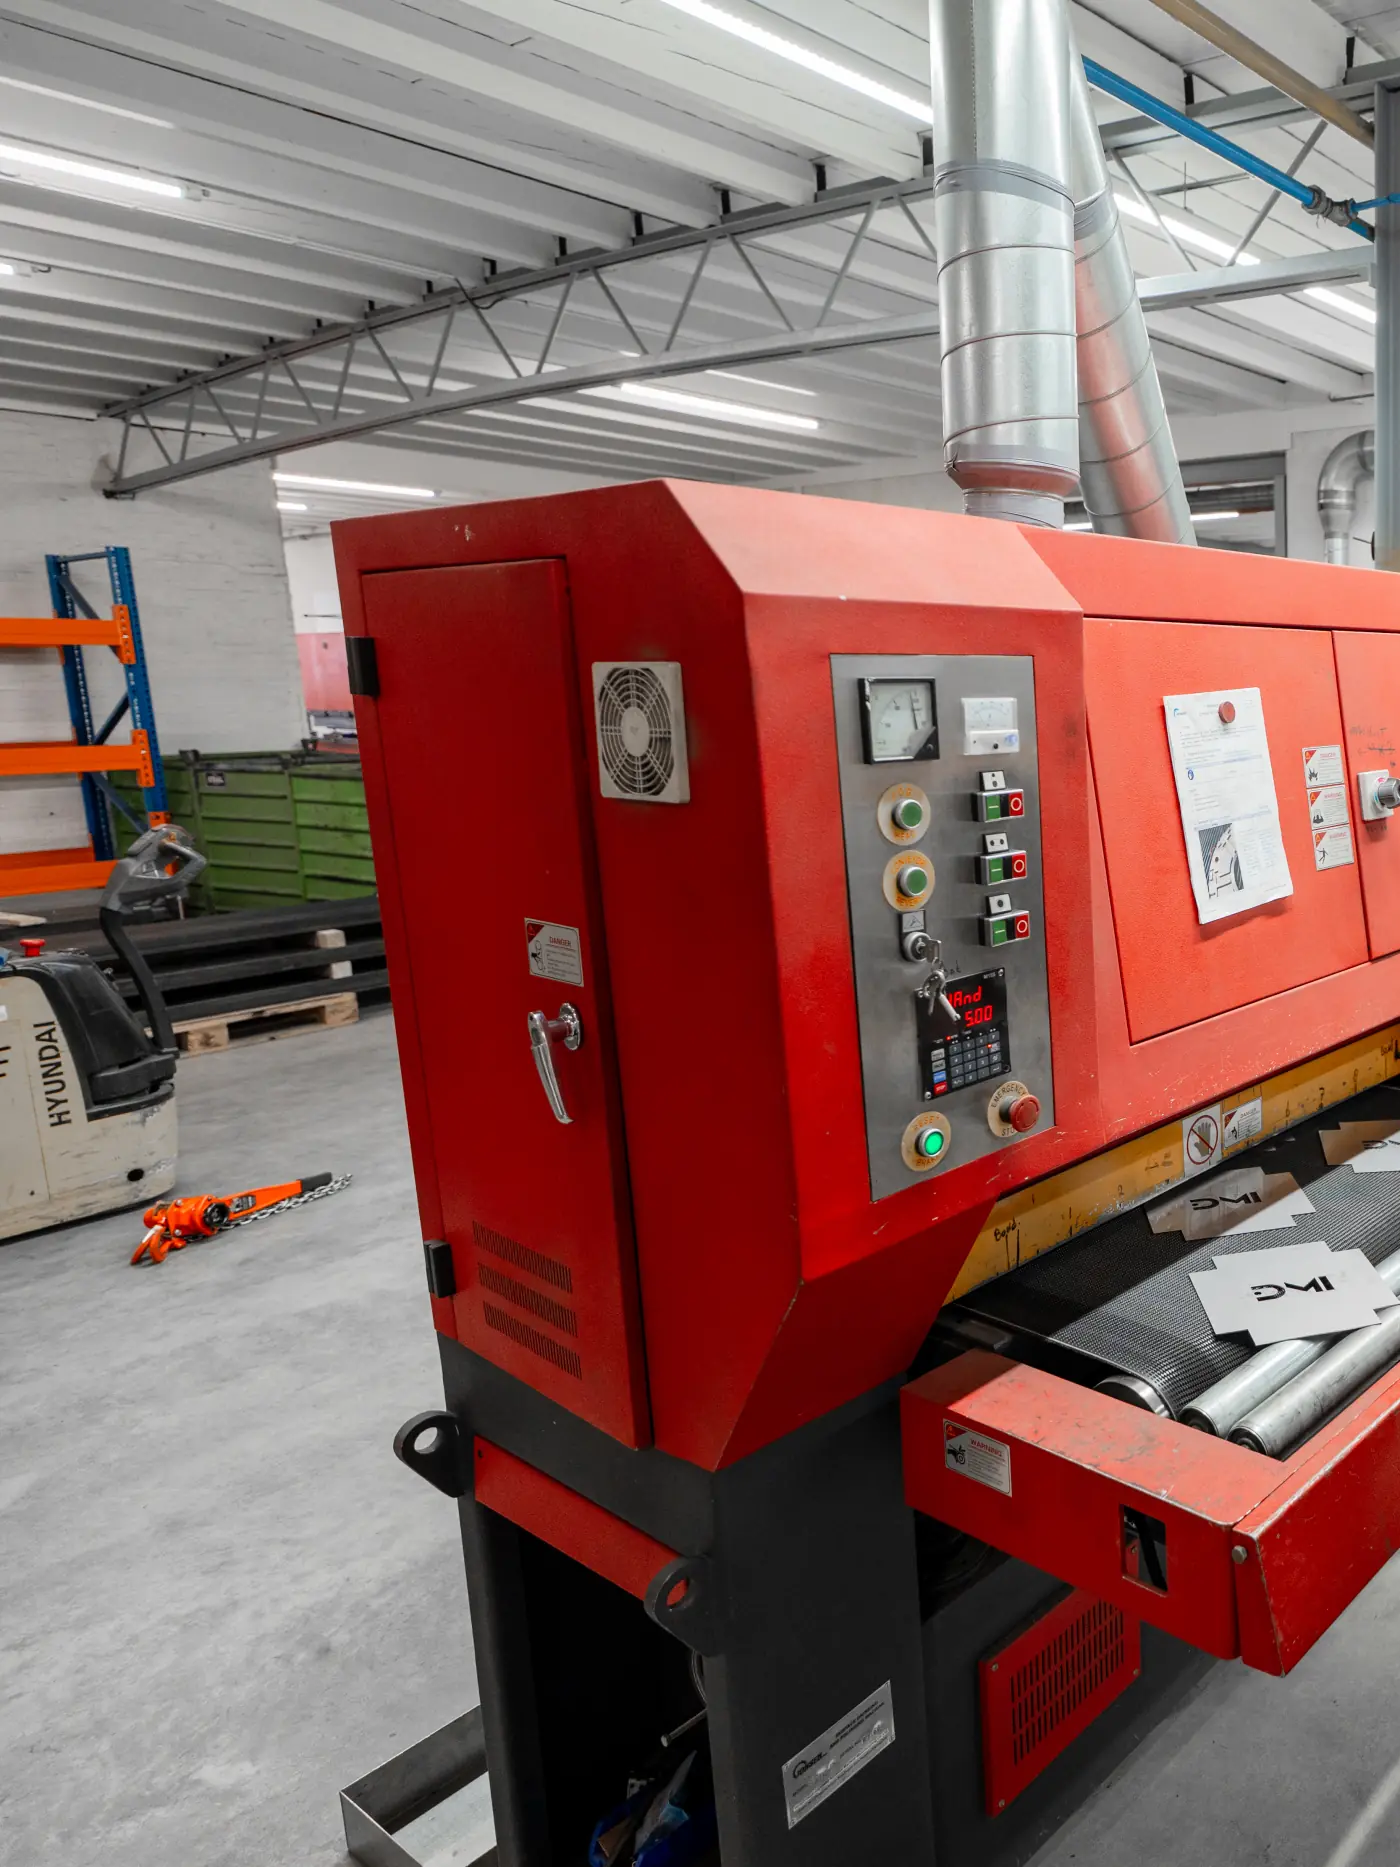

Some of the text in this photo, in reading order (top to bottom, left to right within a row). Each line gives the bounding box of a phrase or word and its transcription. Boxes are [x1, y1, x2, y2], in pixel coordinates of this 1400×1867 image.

[33, 1020, 72, 1128] HYUNDAI
[1189, 1191, 1262, 1211] DMI
[1250, 1275, 1335, 1302] DMI
[970, 1439, 1002, 1458] WARNING
